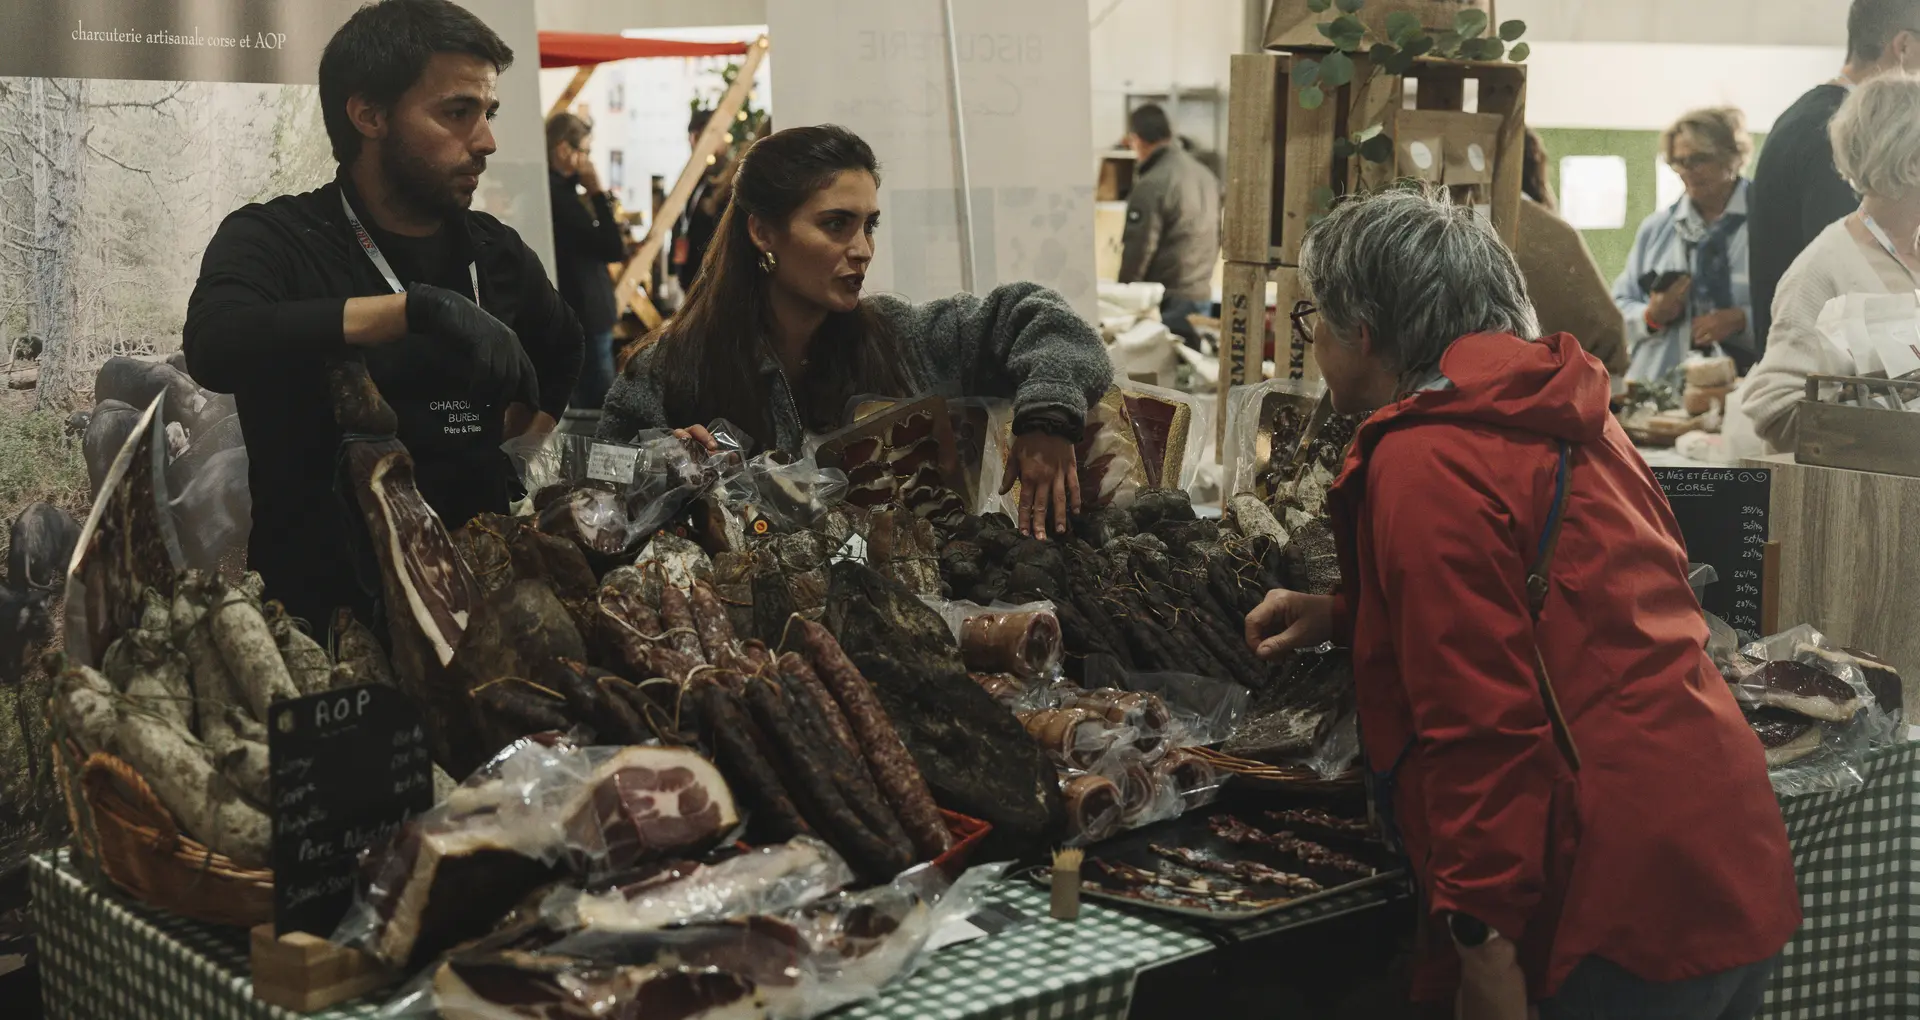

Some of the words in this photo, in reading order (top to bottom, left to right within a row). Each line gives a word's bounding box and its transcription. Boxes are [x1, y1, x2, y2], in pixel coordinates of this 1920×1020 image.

[71, 19, 142, 43] charcuterie
[146, 26, 204, 46] artisanale
[207, 34, 236, 48] corse
[239, 34, 251, 48] et
[254, 32, 286, 49] AOP
[448, 412, 480, 422] BURESI
[444, 426, 460, 434] Père
[461, 425, 467, 433] &
[1677, 483, 1715, 492] CORSE
[315, 689, 371, 727] AOP
